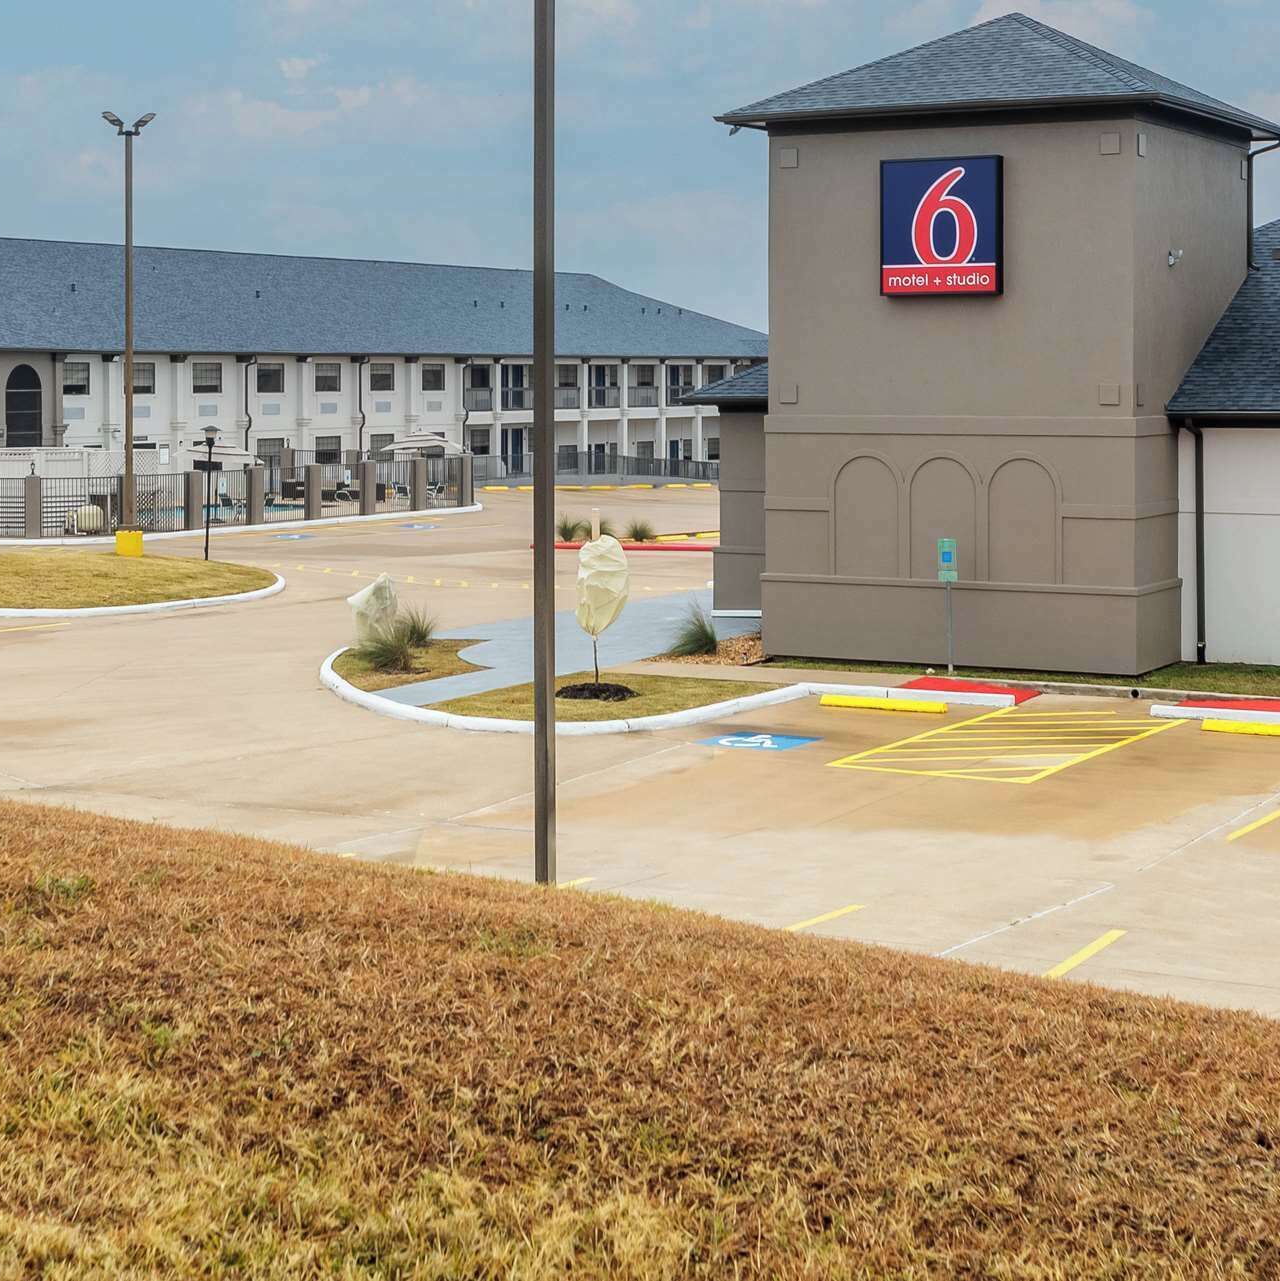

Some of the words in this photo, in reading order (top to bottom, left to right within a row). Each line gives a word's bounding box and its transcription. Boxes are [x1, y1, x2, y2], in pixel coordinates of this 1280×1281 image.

[911, 166, 978, 265] 6
[888, 273, 929, 287] motel
[946, 272, 990, 286] studio
